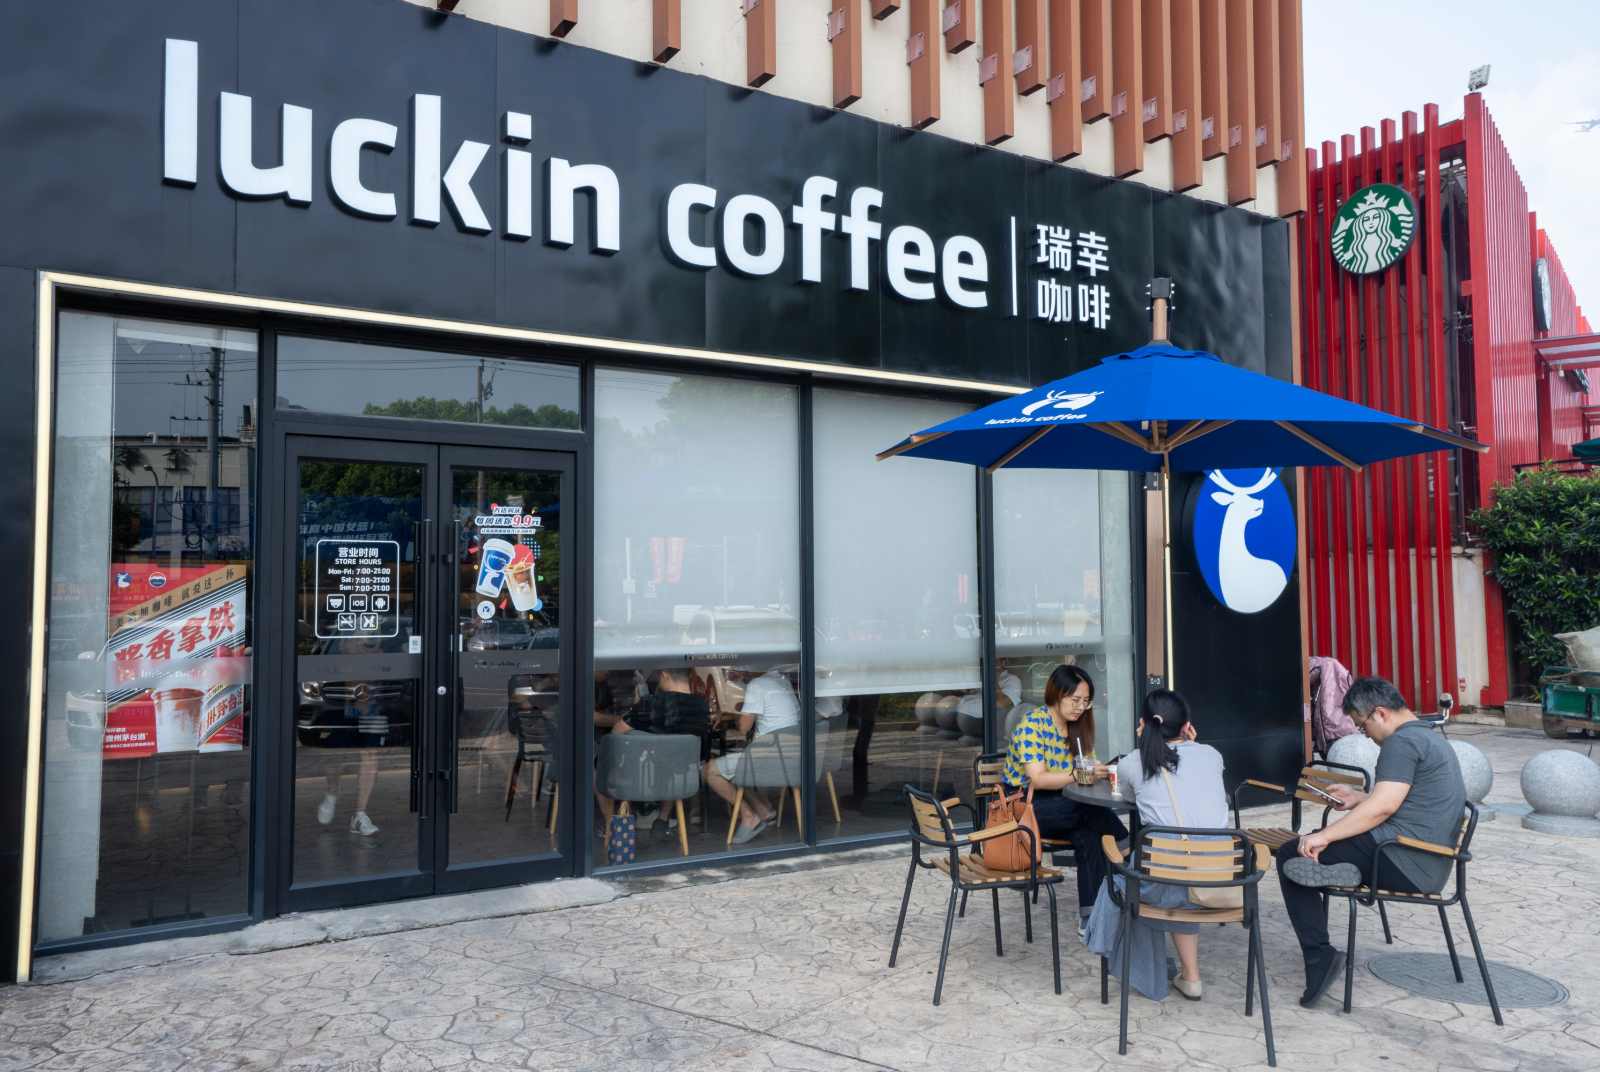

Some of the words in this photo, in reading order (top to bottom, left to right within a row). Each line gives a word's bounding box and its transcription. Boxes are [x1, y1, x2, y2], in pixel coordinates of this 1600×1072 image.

[163, 39, 621, 254] luckin
[667, 175, 989, 310] coffee
[1036, 224, 1110, 278] 瑞幸
[1036, 279, 1111, 331] 咖啡
[984, 416, 1034, 425] luckin
[1034, 413, 1088, 422] coffee
[338, 547, 379, 558] 营业时间
